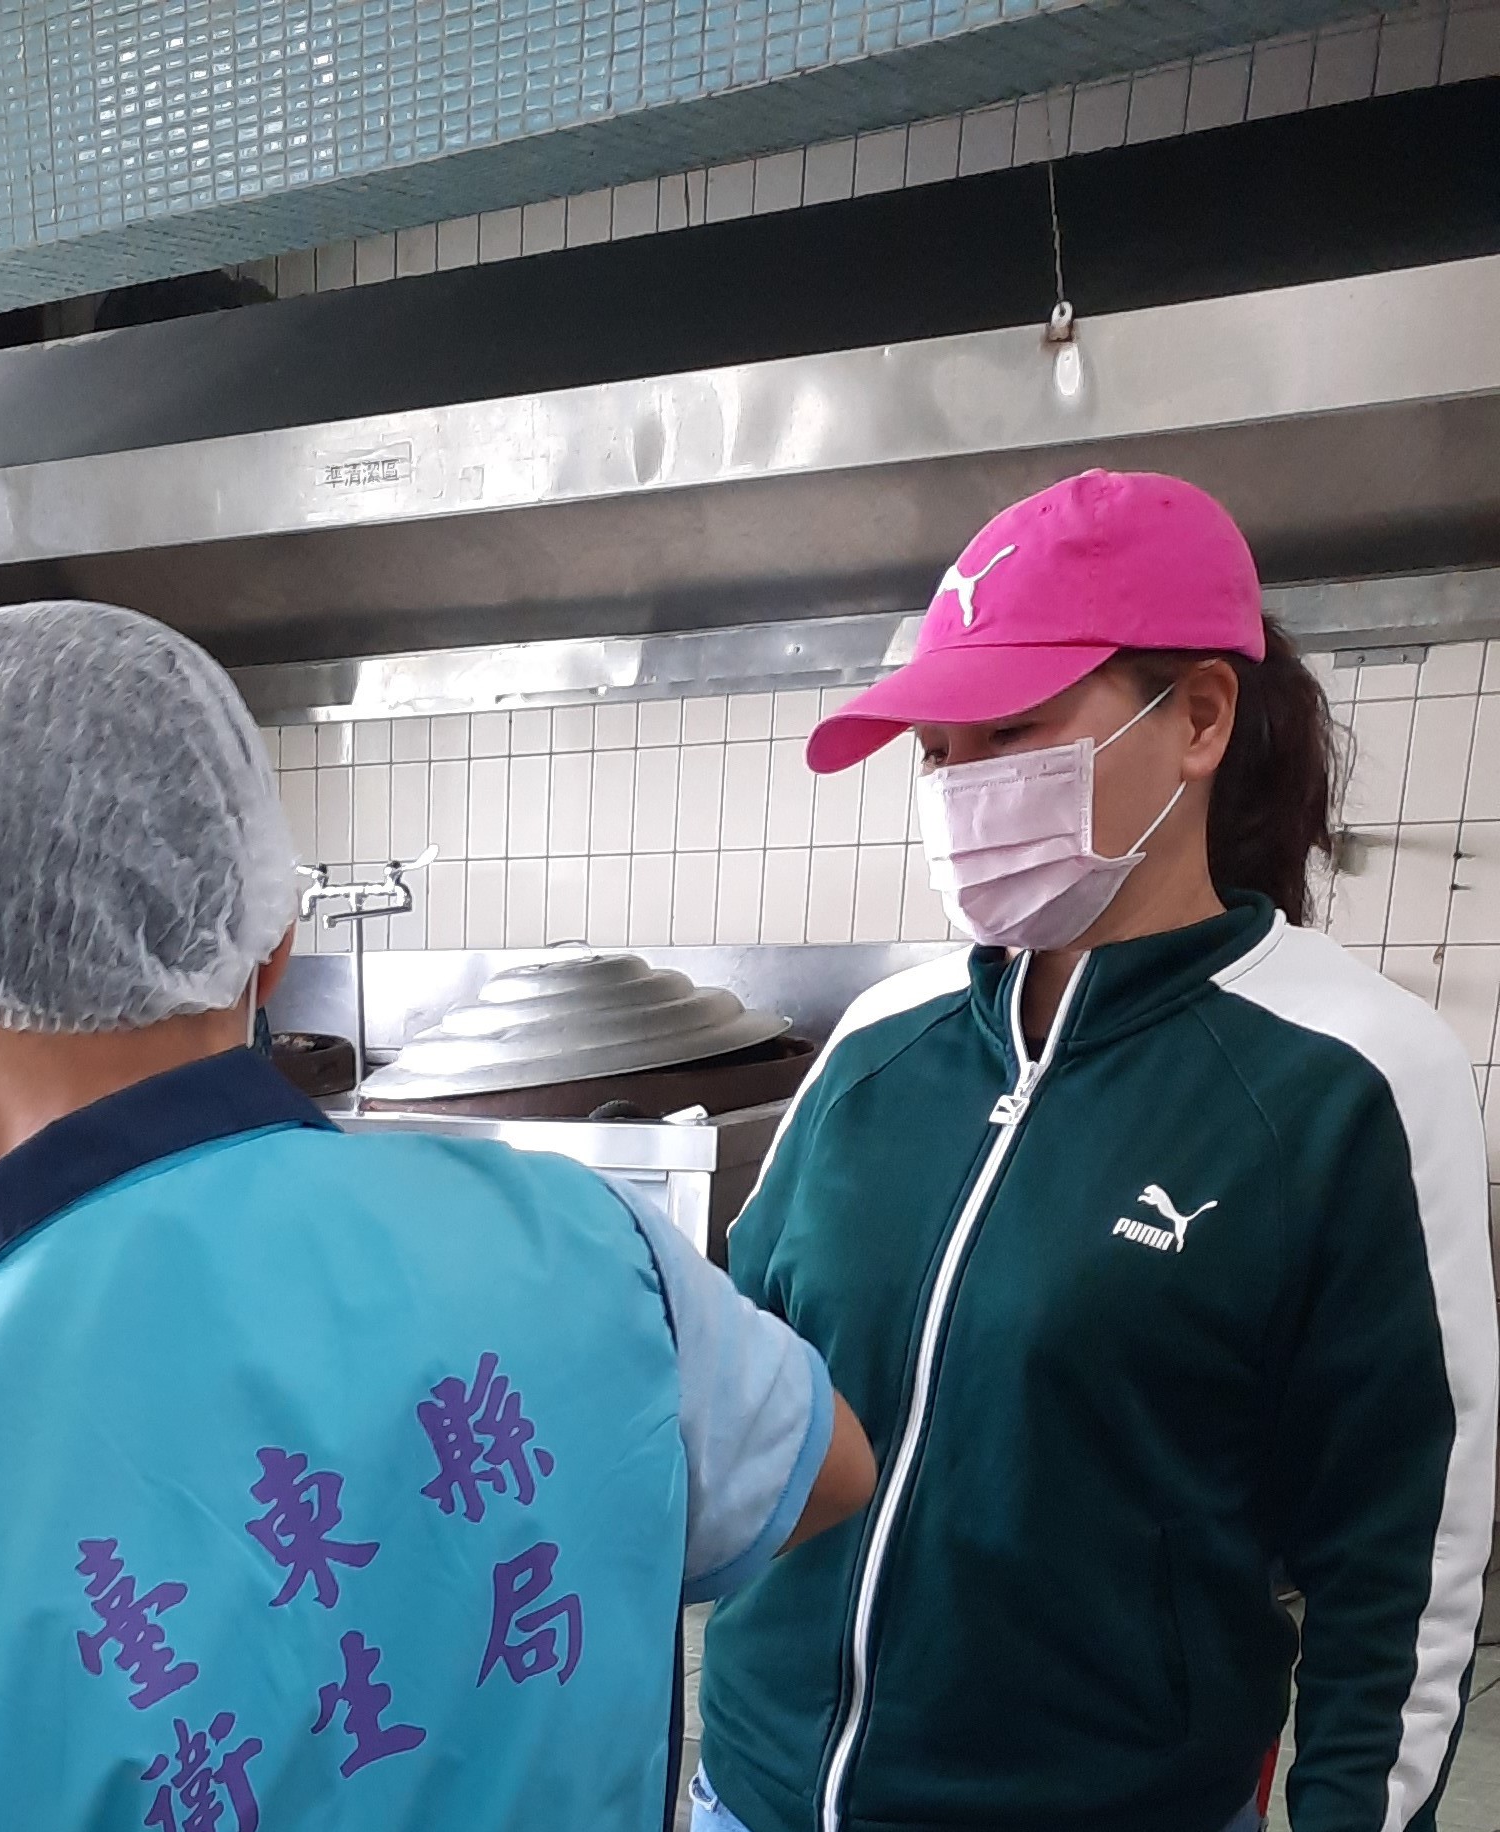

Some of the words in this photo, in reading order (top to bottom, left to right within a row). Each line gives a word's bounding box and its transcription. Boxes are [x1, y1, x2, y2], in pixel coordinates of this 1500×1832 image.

[1112, 1217, 1175, 1250] PUMA
[74, 1352, 554, 1710] 臺東縣
